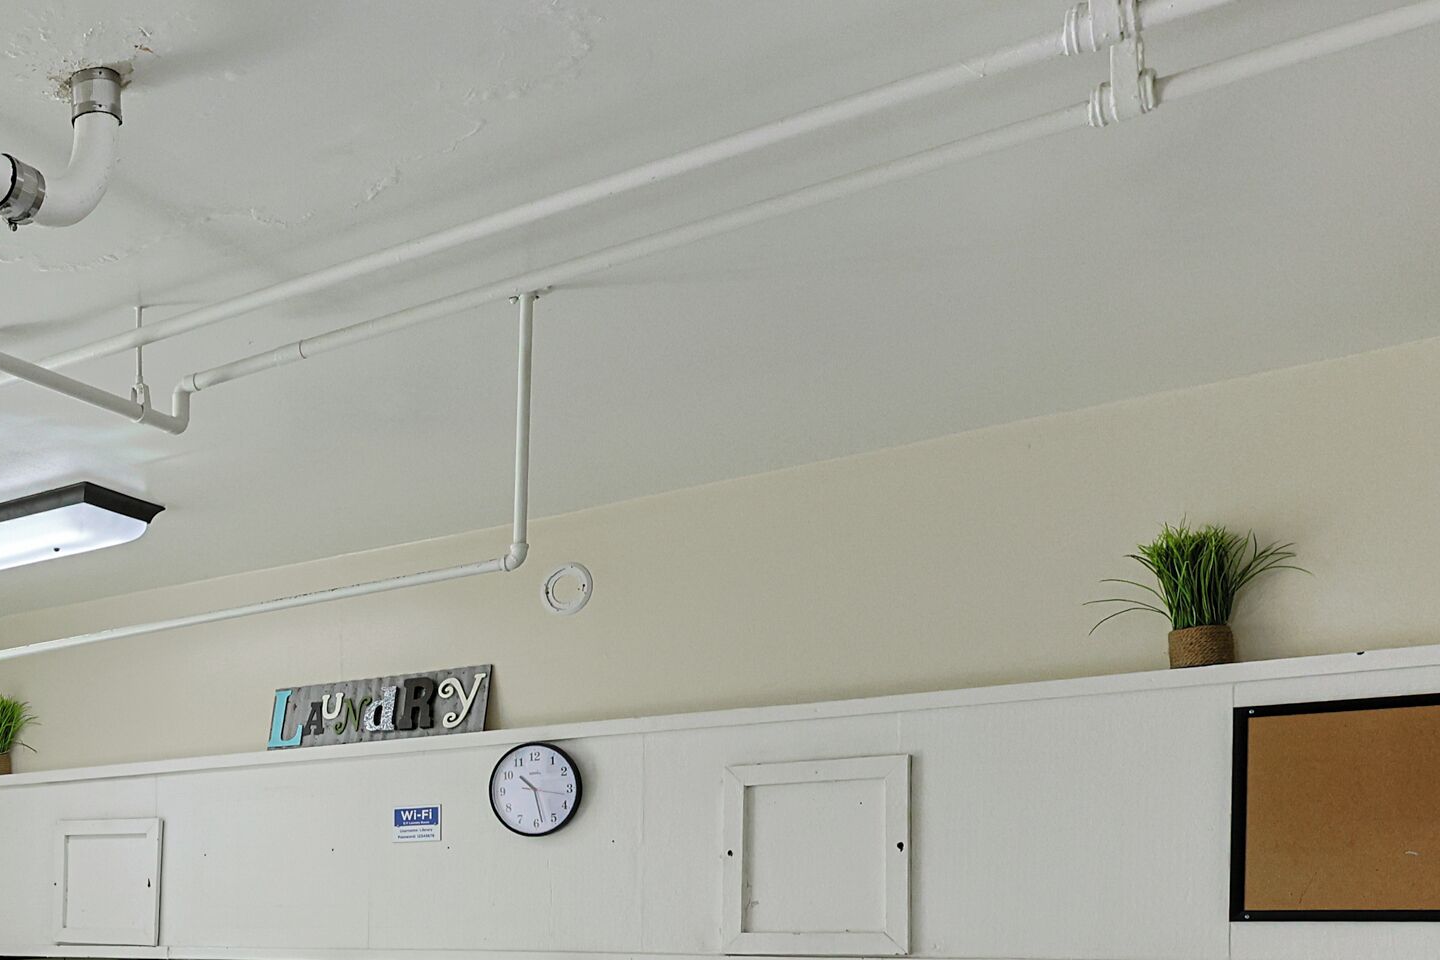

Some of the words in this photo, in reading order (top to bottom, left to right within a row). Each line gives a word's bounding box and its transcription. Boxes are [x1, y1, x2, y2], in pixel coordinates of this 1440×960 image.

[530, 752, 540, 761] 12
[551, 756, 555, 765] 1
[514, 758, 523, 767] 11
[504, 771, 513, 780] 10
[561, 767, 567, 776] 2
[500, 787, 506, 796] 9
[567, 784, 573, 793] 3
[506, 803, 512, 812] 8
[562, 800, 567, 809] 4
[400, 809, 432, 820] Wi-Fi
[551, 814, 557, 822] 5
[517, 815, 523, 824] 7
[534, 819, 539, 828] 6
